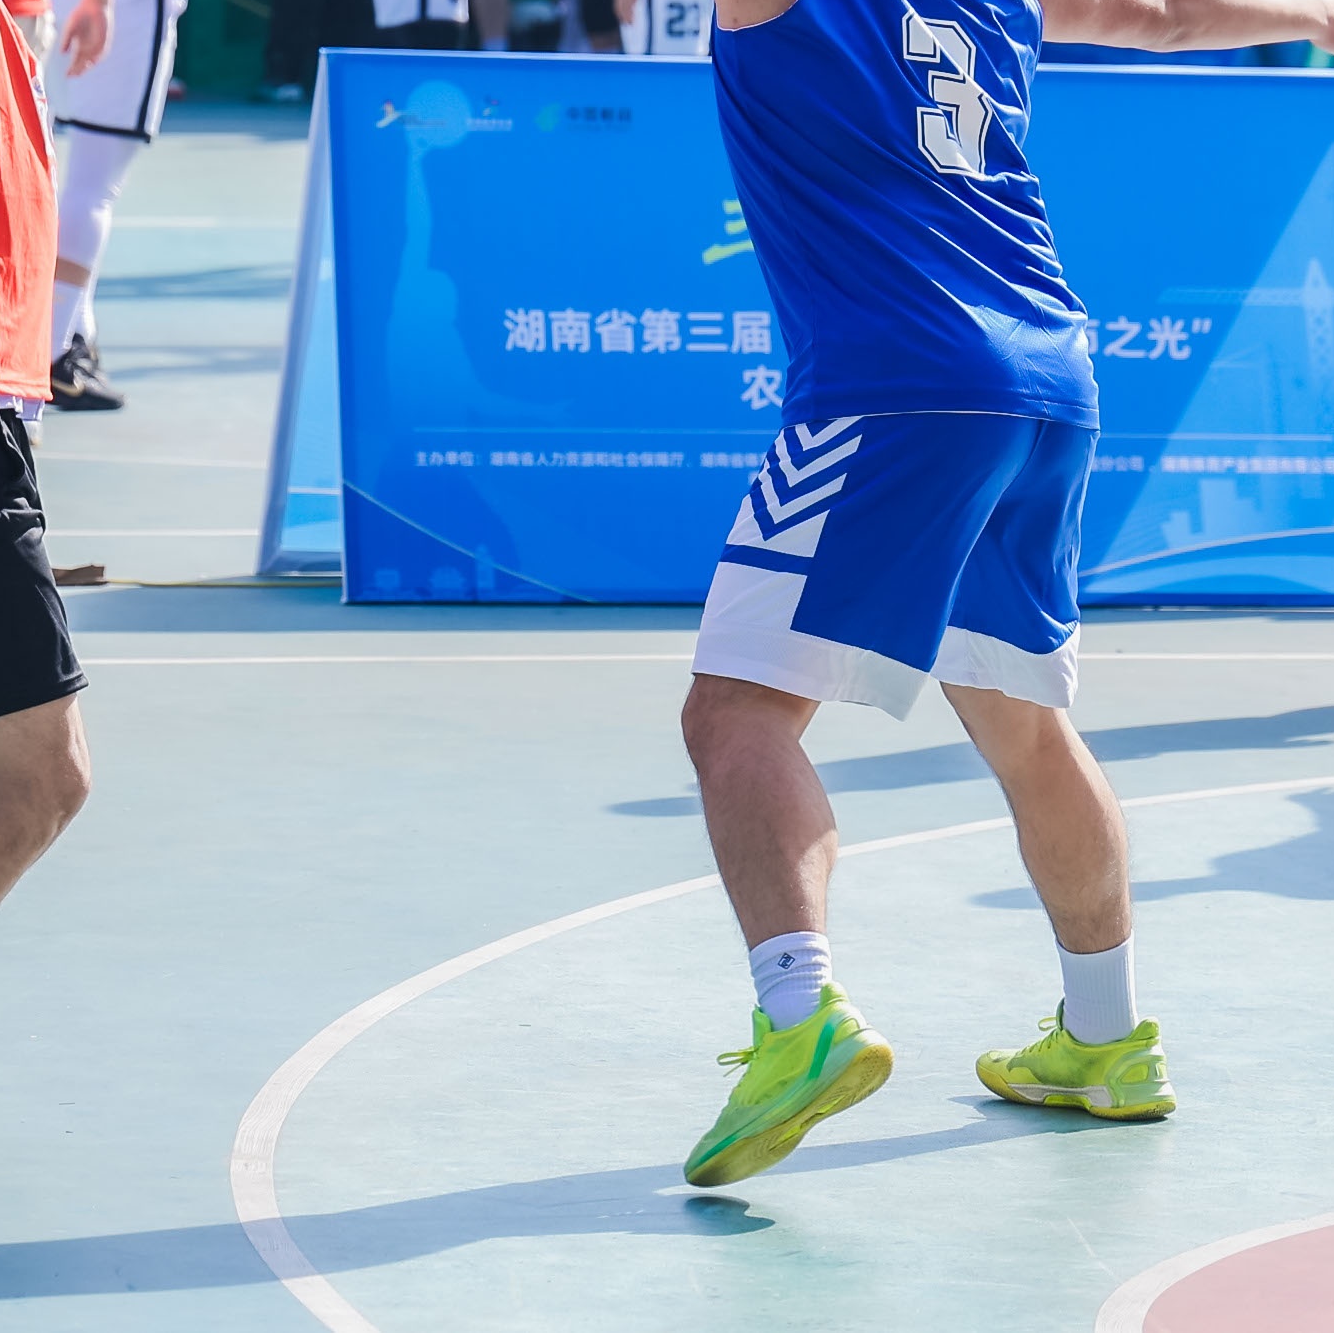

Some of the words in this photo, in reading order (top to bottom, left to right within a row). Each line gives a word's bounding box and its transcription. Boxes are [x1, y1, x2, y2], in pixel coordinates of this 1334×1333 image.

[901, 5, 995, 179] 3
[503, 307, 773, 355] 湖南省第三届
